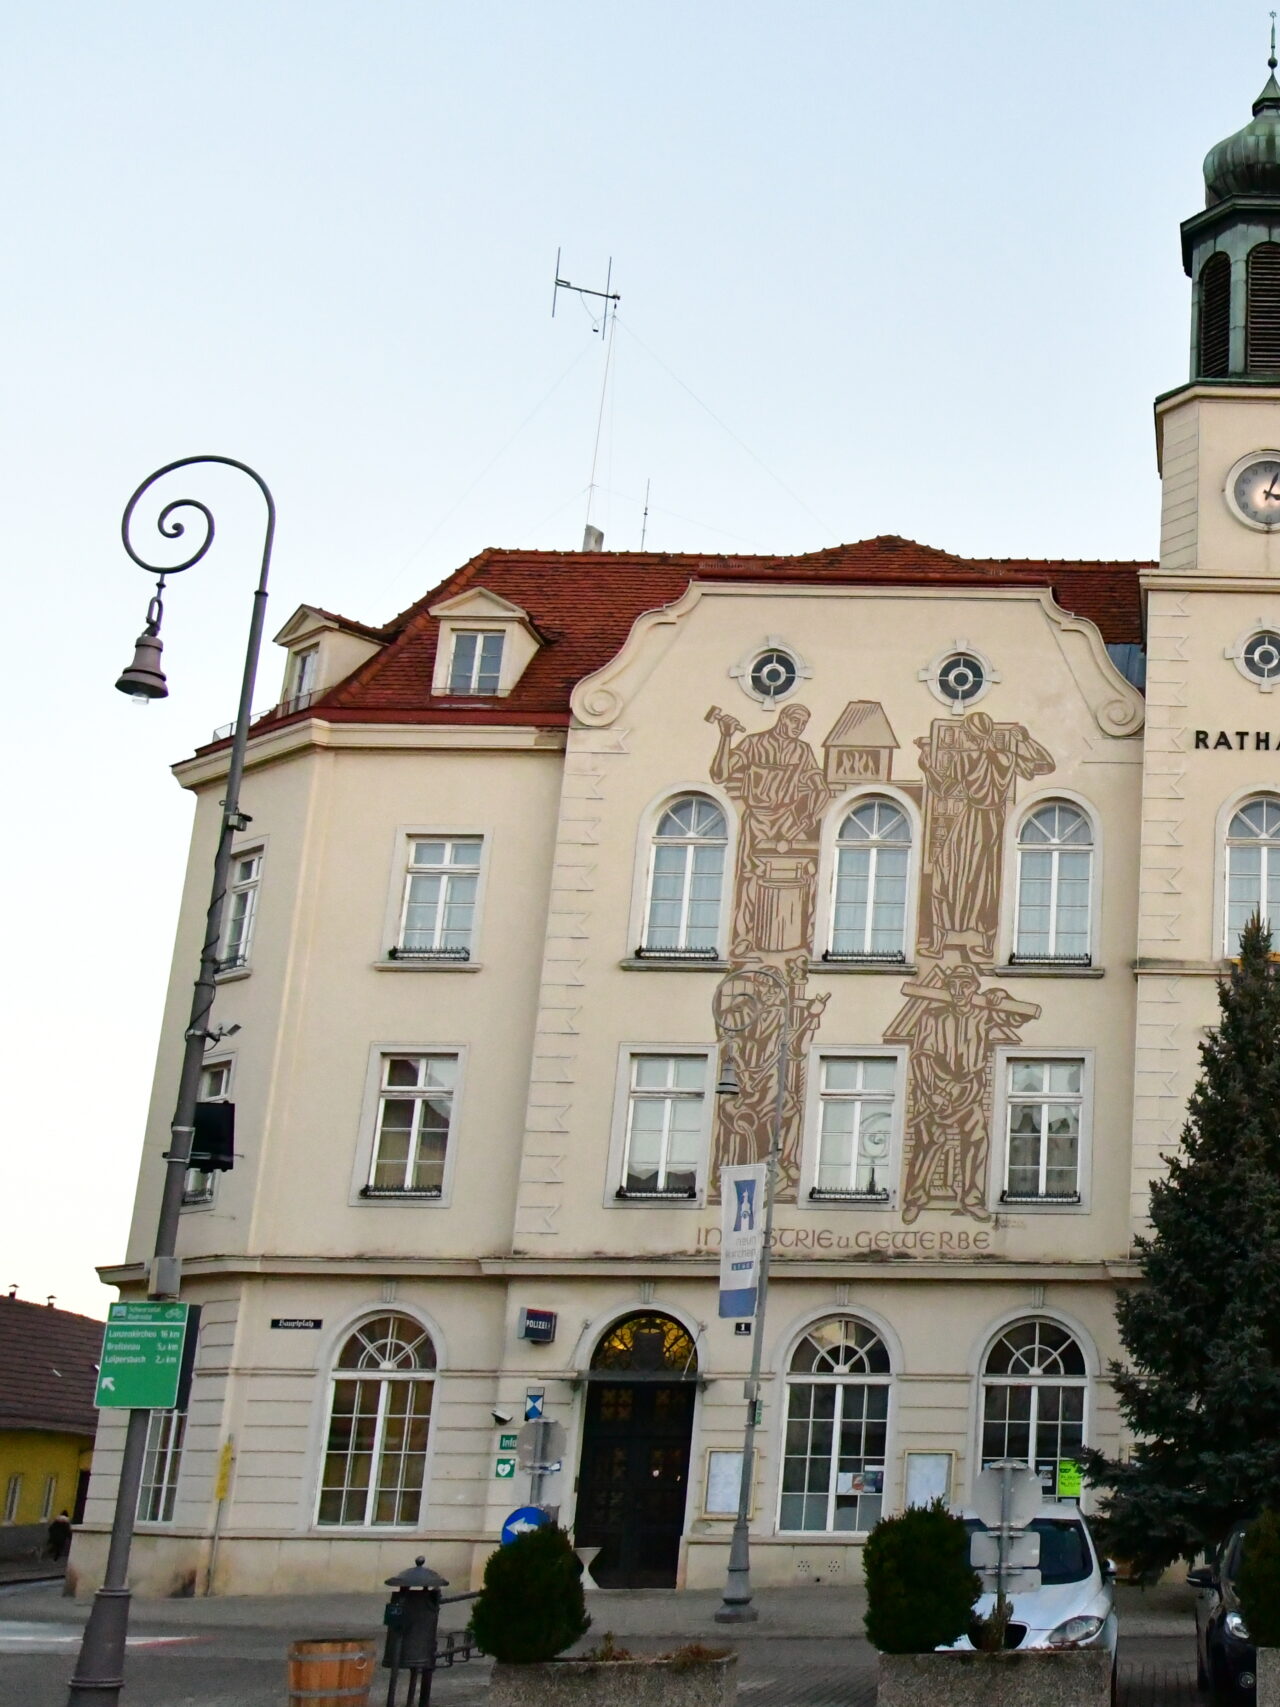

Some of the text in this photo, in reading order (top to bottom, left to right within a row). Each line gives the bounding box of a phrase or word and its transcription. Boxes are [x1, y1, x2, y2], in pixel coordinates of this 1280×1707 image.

[696, 1227, 833, 1249] INSTRIE
[855, 1231, 991, 1251] GEWERBE
[526, 1319, 550, 1330] POLIZEI
[740, 1322, 747, 1331] 1
[108, 1330, 157, 1338] Lanzenkirchen
[169, 1330, 180, 1339] km
[167, 1342, 179, 1351] km
[166, 1355, 177, 1363] km
